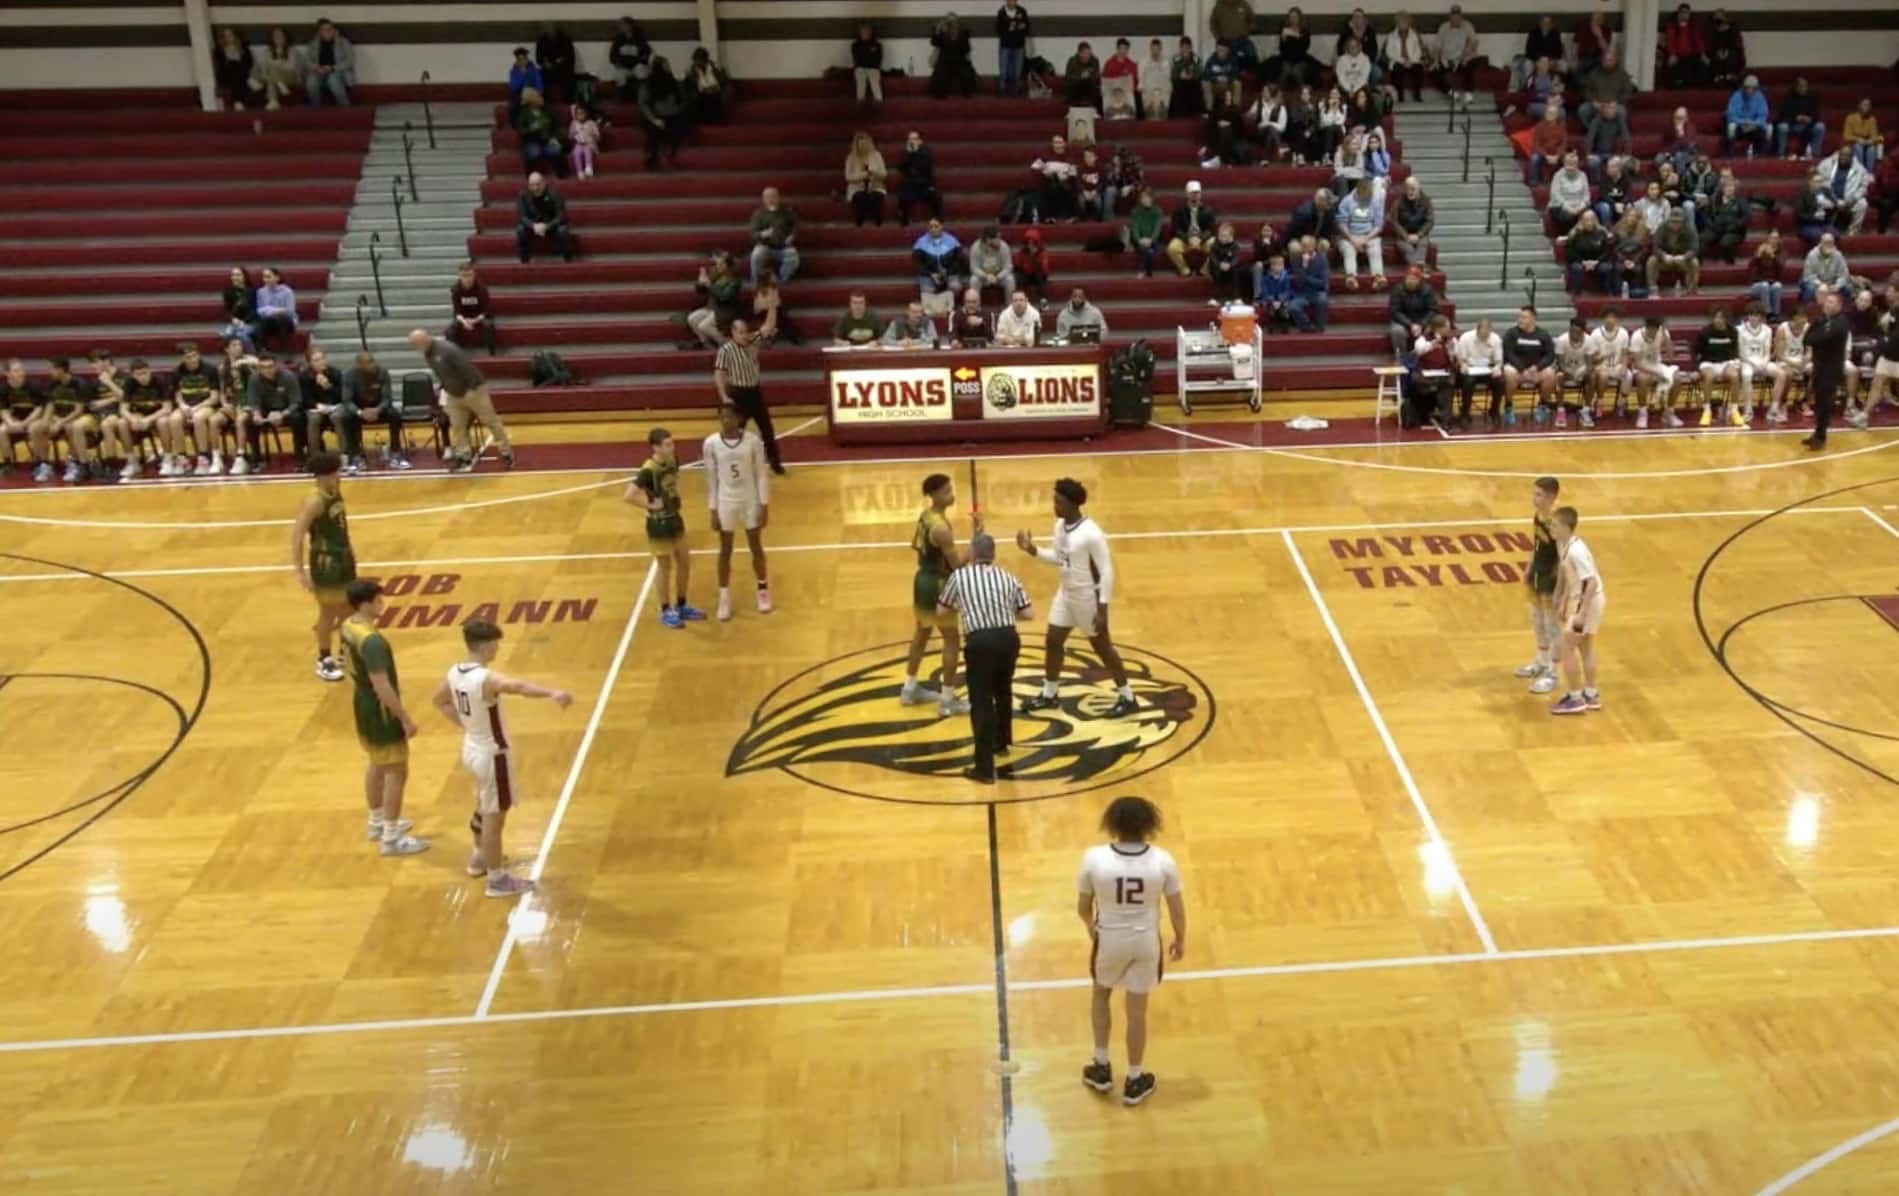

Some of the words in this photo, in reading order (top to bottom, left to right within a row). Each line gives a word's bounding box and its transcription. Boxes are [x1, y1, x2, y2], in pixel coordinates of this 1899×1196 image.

[836, 379, 946, 409] LYONS
[953, 382, 980, 394] POSS
[1018, 376, 1095, 405] LIONS
[857, 410, 883, 418] HIGH
[885, 408, 927, 418] SCHOOL
[730, 463, 740, 479] 5
[1328, 531, 1535, 559] MYRON
[357, 573, 462, 597] OB
[1115, 876, 1144, 905] 12
